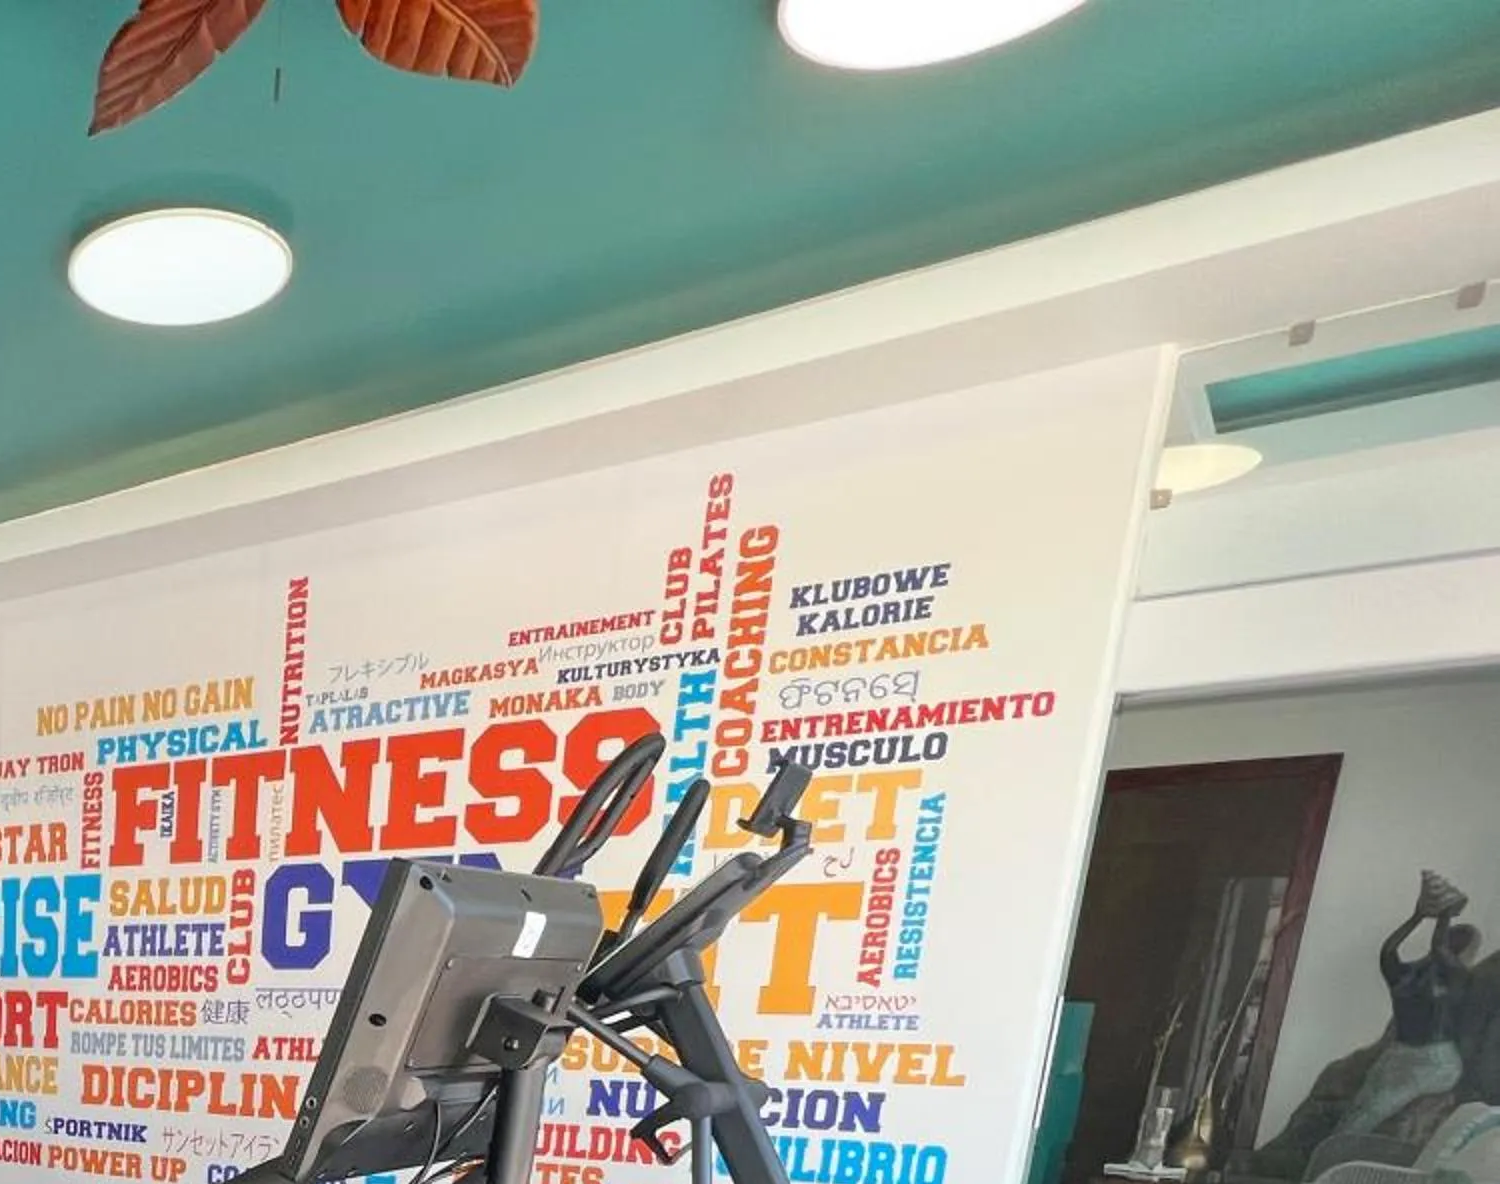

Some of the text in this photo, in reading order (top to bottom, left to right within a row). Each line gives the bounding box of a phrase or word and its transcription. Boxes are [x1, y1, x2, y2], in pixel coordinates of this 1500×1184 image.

[691, 473, 734, 641] PILATES
[660, 547, 692, 645] CLUB
[790, 563, 951, 609] KLUBOWE
[508, 610, 655, 647] ENTRAINEMENT
[796, 596, 935, 636] KALORIE
[280, 576, 309, 746] NUTRITION
[557, 648, 720, 684] KULTURYSTYKA
[711, 524, 780, 777] COACHING
[769, 624, 989, 674] CONSTANCIA
[37, 676, 255, 736] NO PAIN NO GAIN
[308, 690, 471, 734] ATRACTIVE
[489, 685, 602, 718] MONAKA
[612, 679, 666, 701] BODY
[760, 691, 1055, 743] ENTRENAMIENTO
[97, 720, 267, 765] PHYSICAL
[766, 731, 948, 774] MUSCULO
[109, 707, 661, 866] FITNESS
[704, 768, 922, 849] DET
[81, 771, 104, 869] FITNESS
[110, 875, 226, 916] SALUD
[894, 792, 946, 979] RESISTENCIA
[227, 868, 255, 984] CLUB
[857, 847, 900, 987] AEROBICS
[103, 923, 226, 957] ATHLETE
[108, 965, 219, 992] AEROBICS
[69, 999, 197, 1026] CALORIES
[817, 1013, 919, 1030] ATHLETE
[71, 1031, 245, 1063] ROMPE TUS LIMITES
[252, 1036, 321, 1061] ATHL
[784, 1041, 965, 1086] NIVEL
[81, 1064, 300, 1120] DICIPLIN
[586, 1079, 886, 1132] NUCION
[48, 1145, 187, 1184] POWER UP
